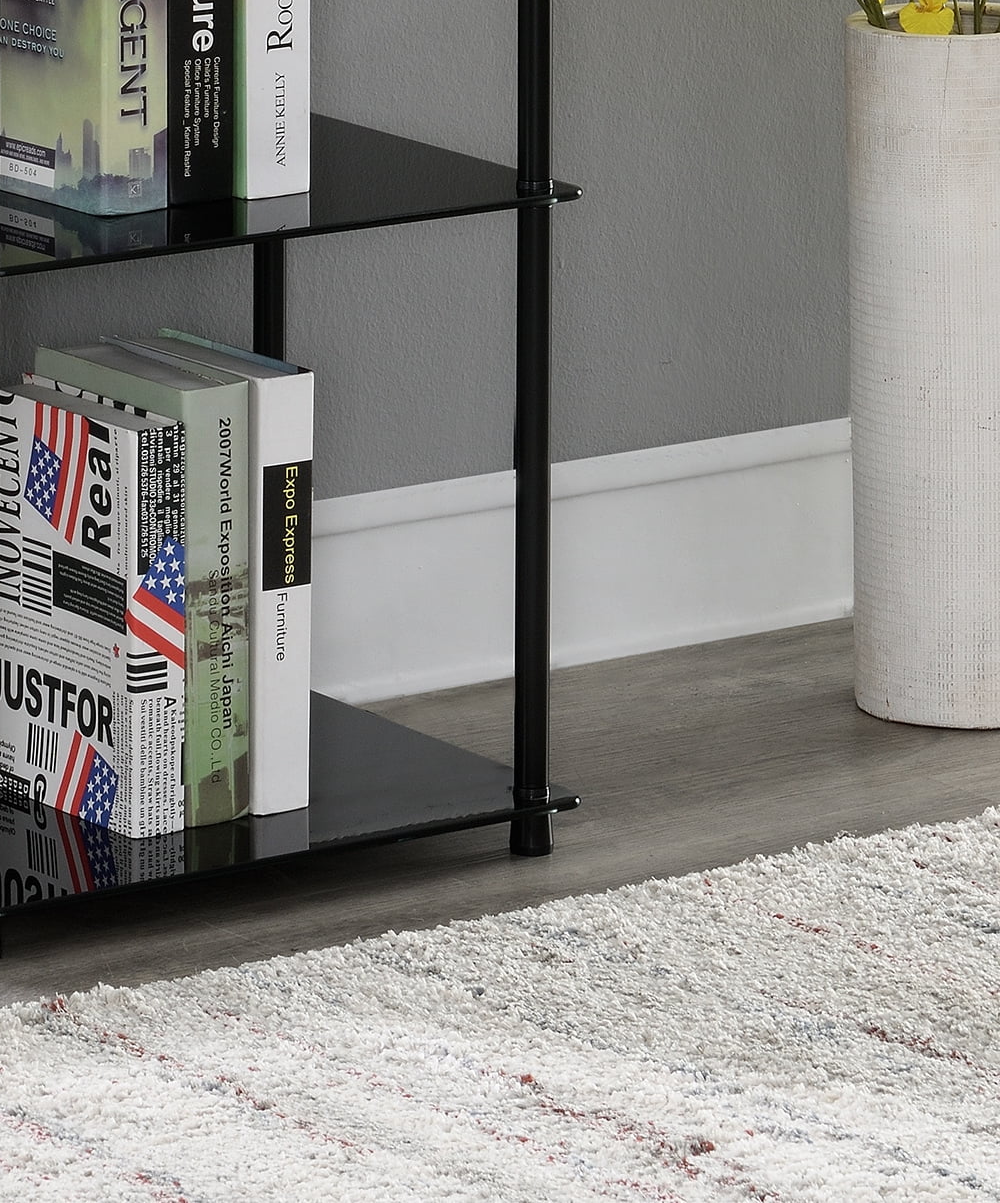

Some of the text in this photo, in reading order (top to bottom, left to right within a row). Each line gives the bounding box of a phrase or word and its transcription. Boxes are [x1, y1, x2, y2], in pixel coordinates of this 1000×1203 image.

[0, 17, 57, 41] ONE CHOICE
[11, 37, 47, 55] DESTROY
[48, 46, 64, 59] YOU
[184, 59, 192, 88] Special
[194, 58, 202, 81] Office
[213, 56, 221, 85] Current
[192, 117, 201, 146] System
[212, 121, 220, 148] Design
[274, 72, 287, 168] ANNIE KELLY
[166, 430, 172, 438] 3
[173, 463, 179, 473] 29
[156, 470, 164, 504] rispedire
[173, 492, 179, 503] 31
[164, 506, 172, 534] meglio
[282, 465, 299, 584] Expo Express
[218, 519, 233, 617] Exposition
[209, 569, 220, 619] Sandu
[275, 592, 289, 662] Furniture
[209, 620, 220, 674] Cultural
[220, 621, 235, 669] Aichi
[163, 696, 177, 709] A
[210, 677, 221, 724] Medio
[219, 674, 235, 730] Japan
[163, 758, 169, 769] on
